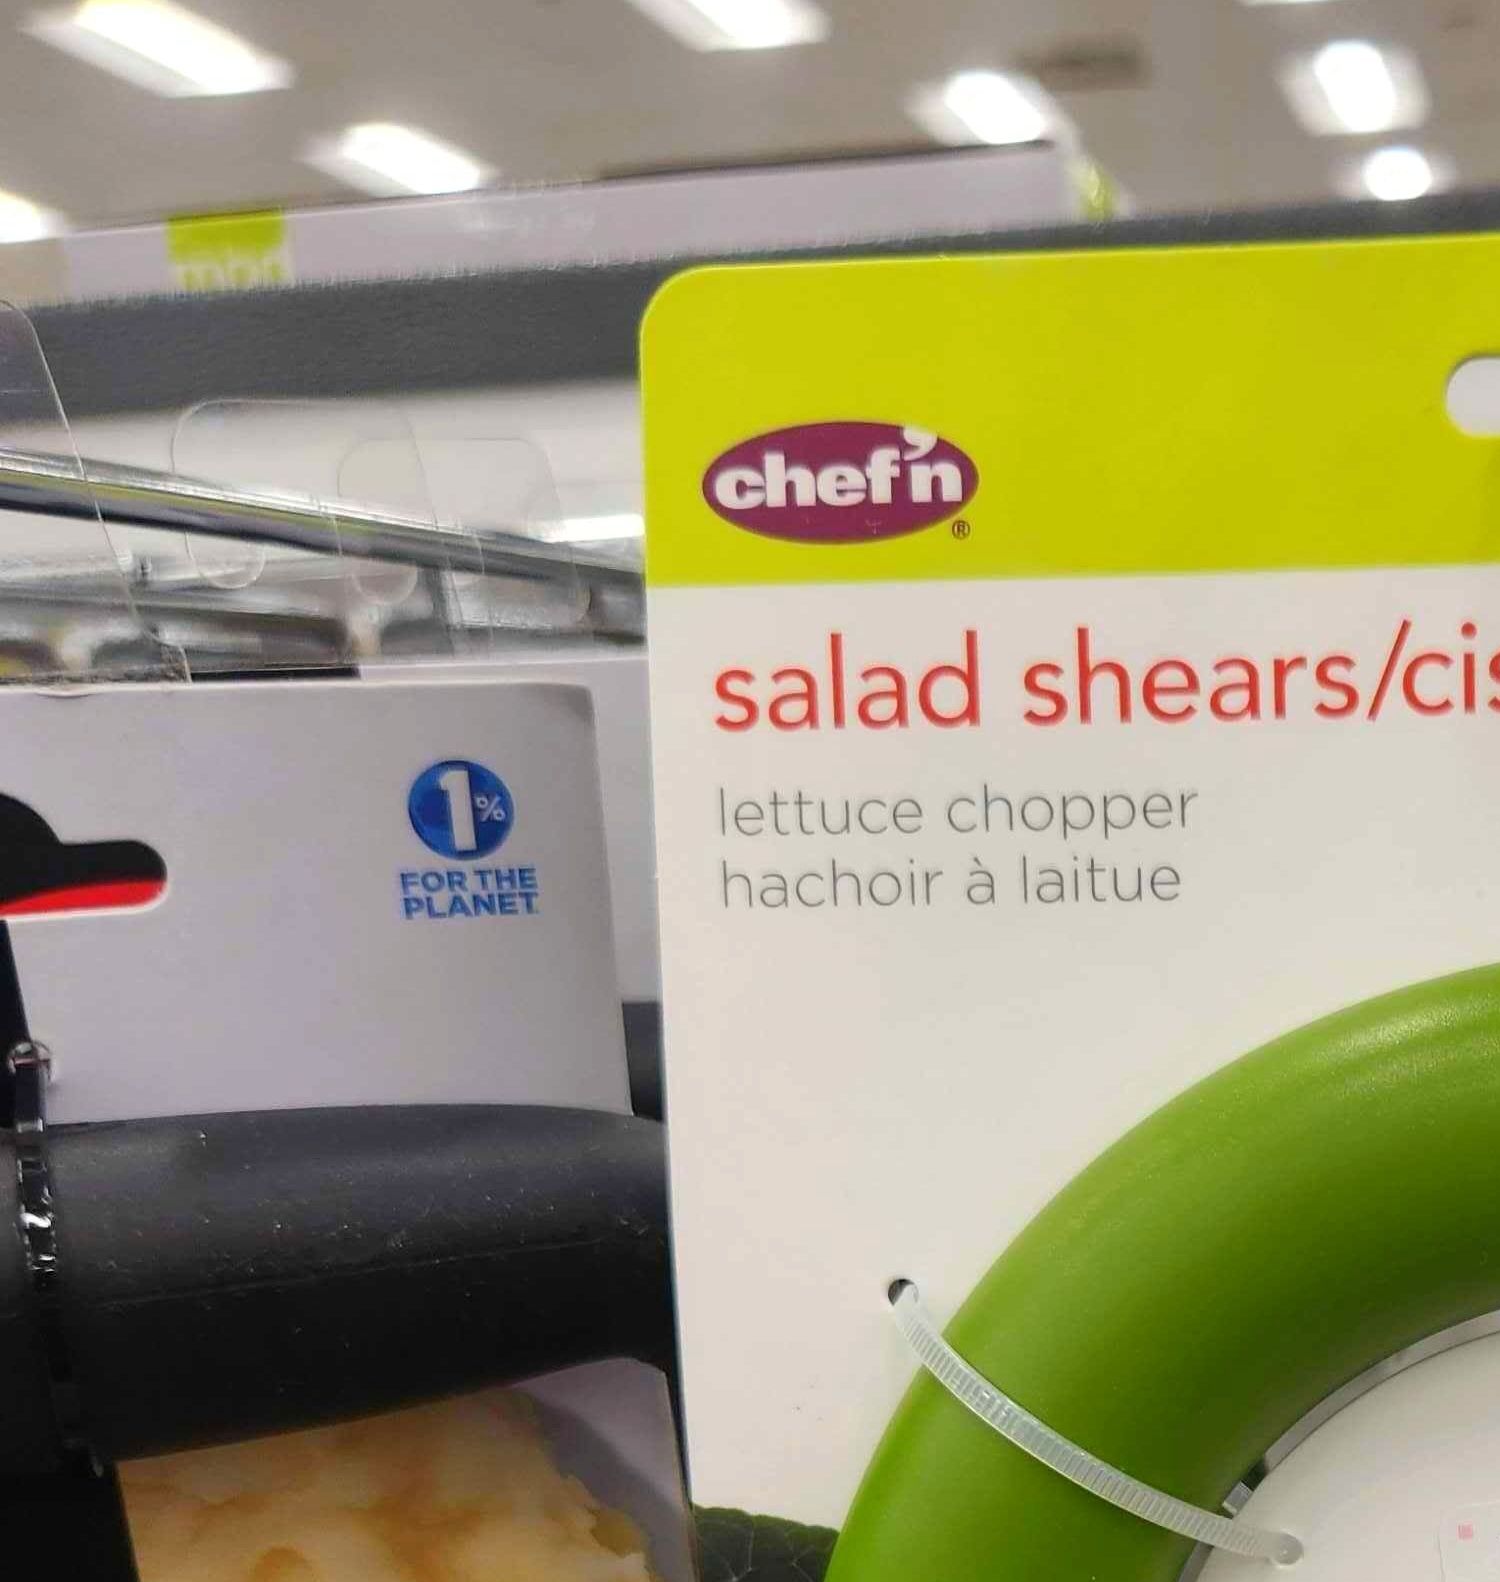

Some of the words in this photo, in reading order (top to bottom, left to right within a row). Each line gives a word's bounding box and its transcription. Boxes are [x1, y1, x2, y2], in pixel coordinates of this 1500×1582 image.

[714, 425, 963, 510] chef'n
[714, 630, 981, 732] salad
[719, 786, 924, 837] lettuce
[947, 783, 1198, 840] chopper
[400, 870, 468, 894] FOR
[473, 868, 538, 891] THE
[402, 892, 540, 919] PLANET
[722, 858, 943, 909] hachoir
[965, 857, 997, 905] à
[1022, 854, 1181, 903] laitue
